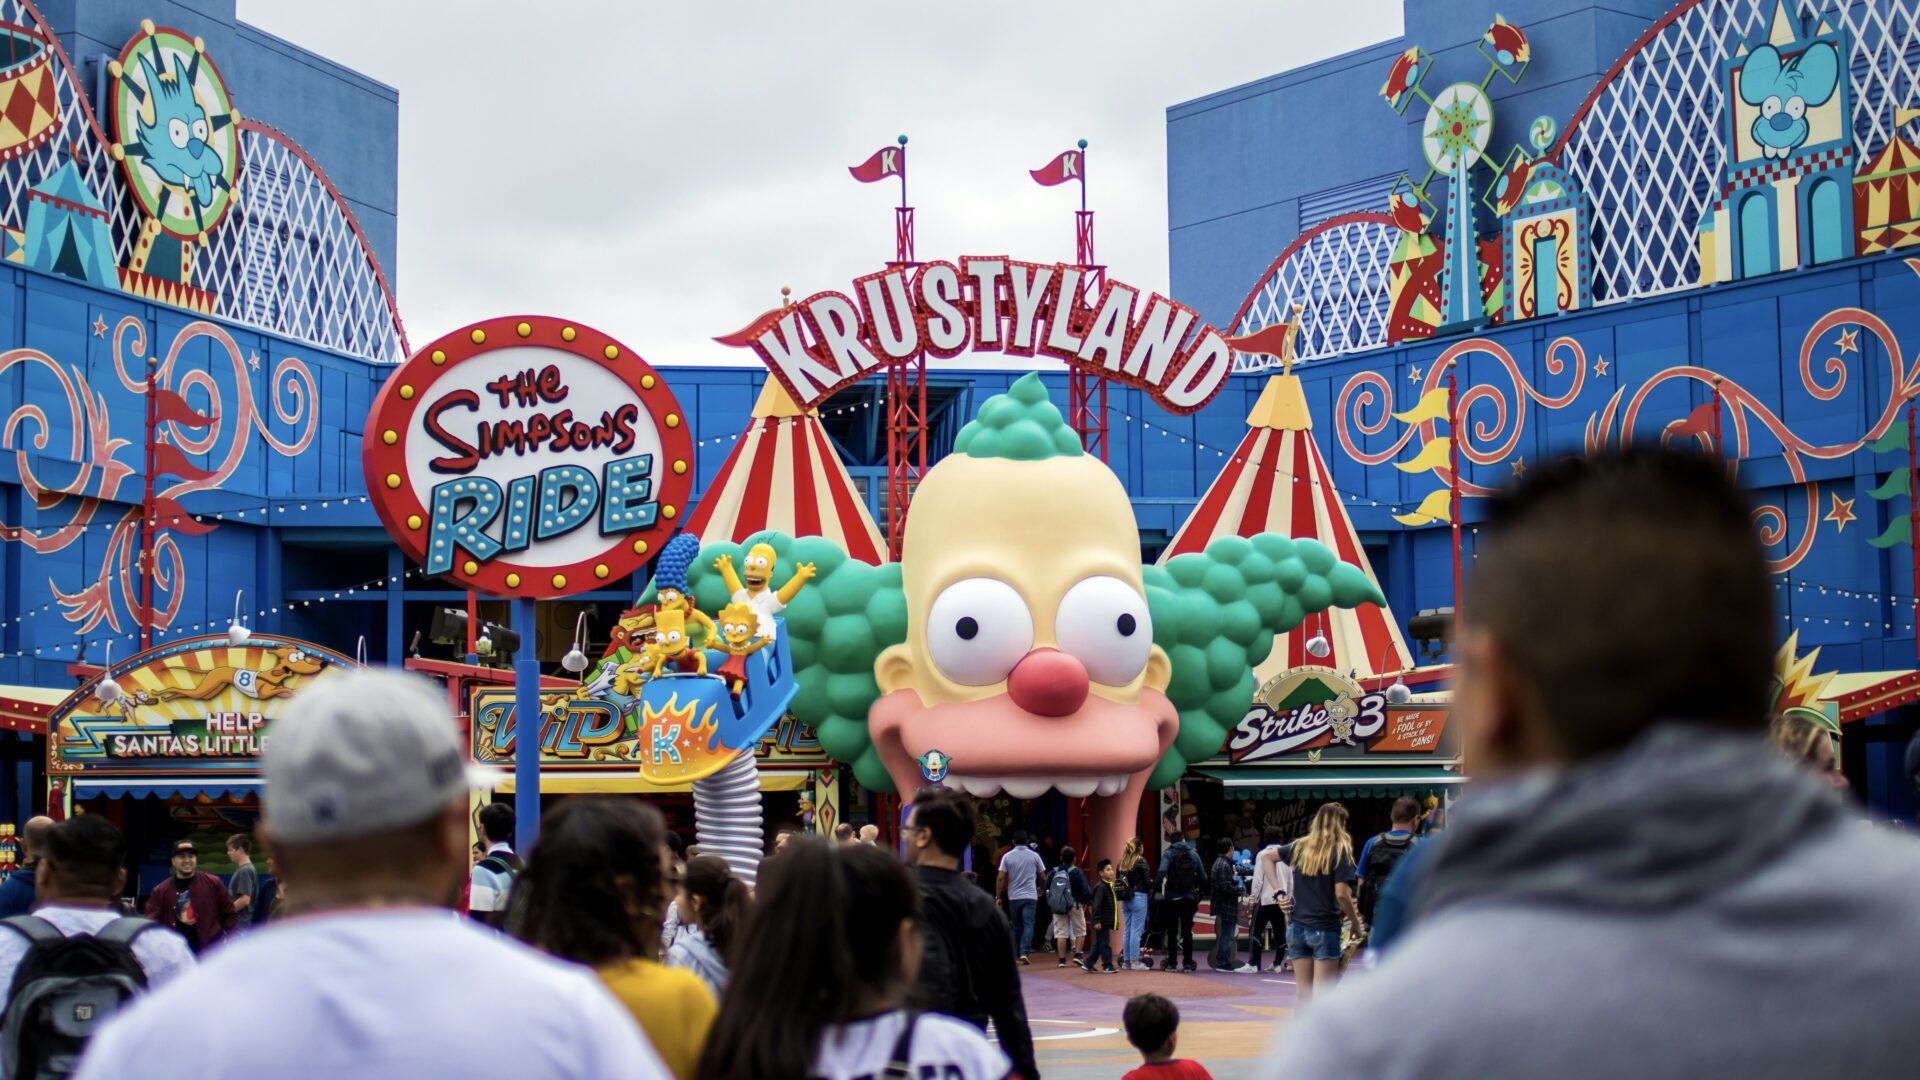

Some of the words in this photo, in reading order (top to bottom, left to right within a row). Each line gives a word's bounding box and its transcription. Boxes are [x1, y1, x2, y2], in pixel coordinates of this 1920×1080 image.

[881, 150, 898, 175] K
[1062, 153, 1078, 178] K
[757, 259, 1234, 409] KRUSTYLAND
[423, 389, 639, 475] SIMPSONS
[422, 453, 661, 579] RIDE
[238, 672, 251, 687] 8
[206, 712, 264, 733] HELP
[1230, 703, 1330, 750] Strike
[1354, 695, 1385, 738] 3
[1396, 721, 1415, 733] FOOL
[1405, 712, 1420, 721] MADE
[114, 734, 200, 755] SANTA'S
[651, 724, 682, 765] K
[1402, 730, 1418, 739] STACK
[1411, 734, 1435, 748] CANS!
[1263, 799, 1307, 826] SWING
